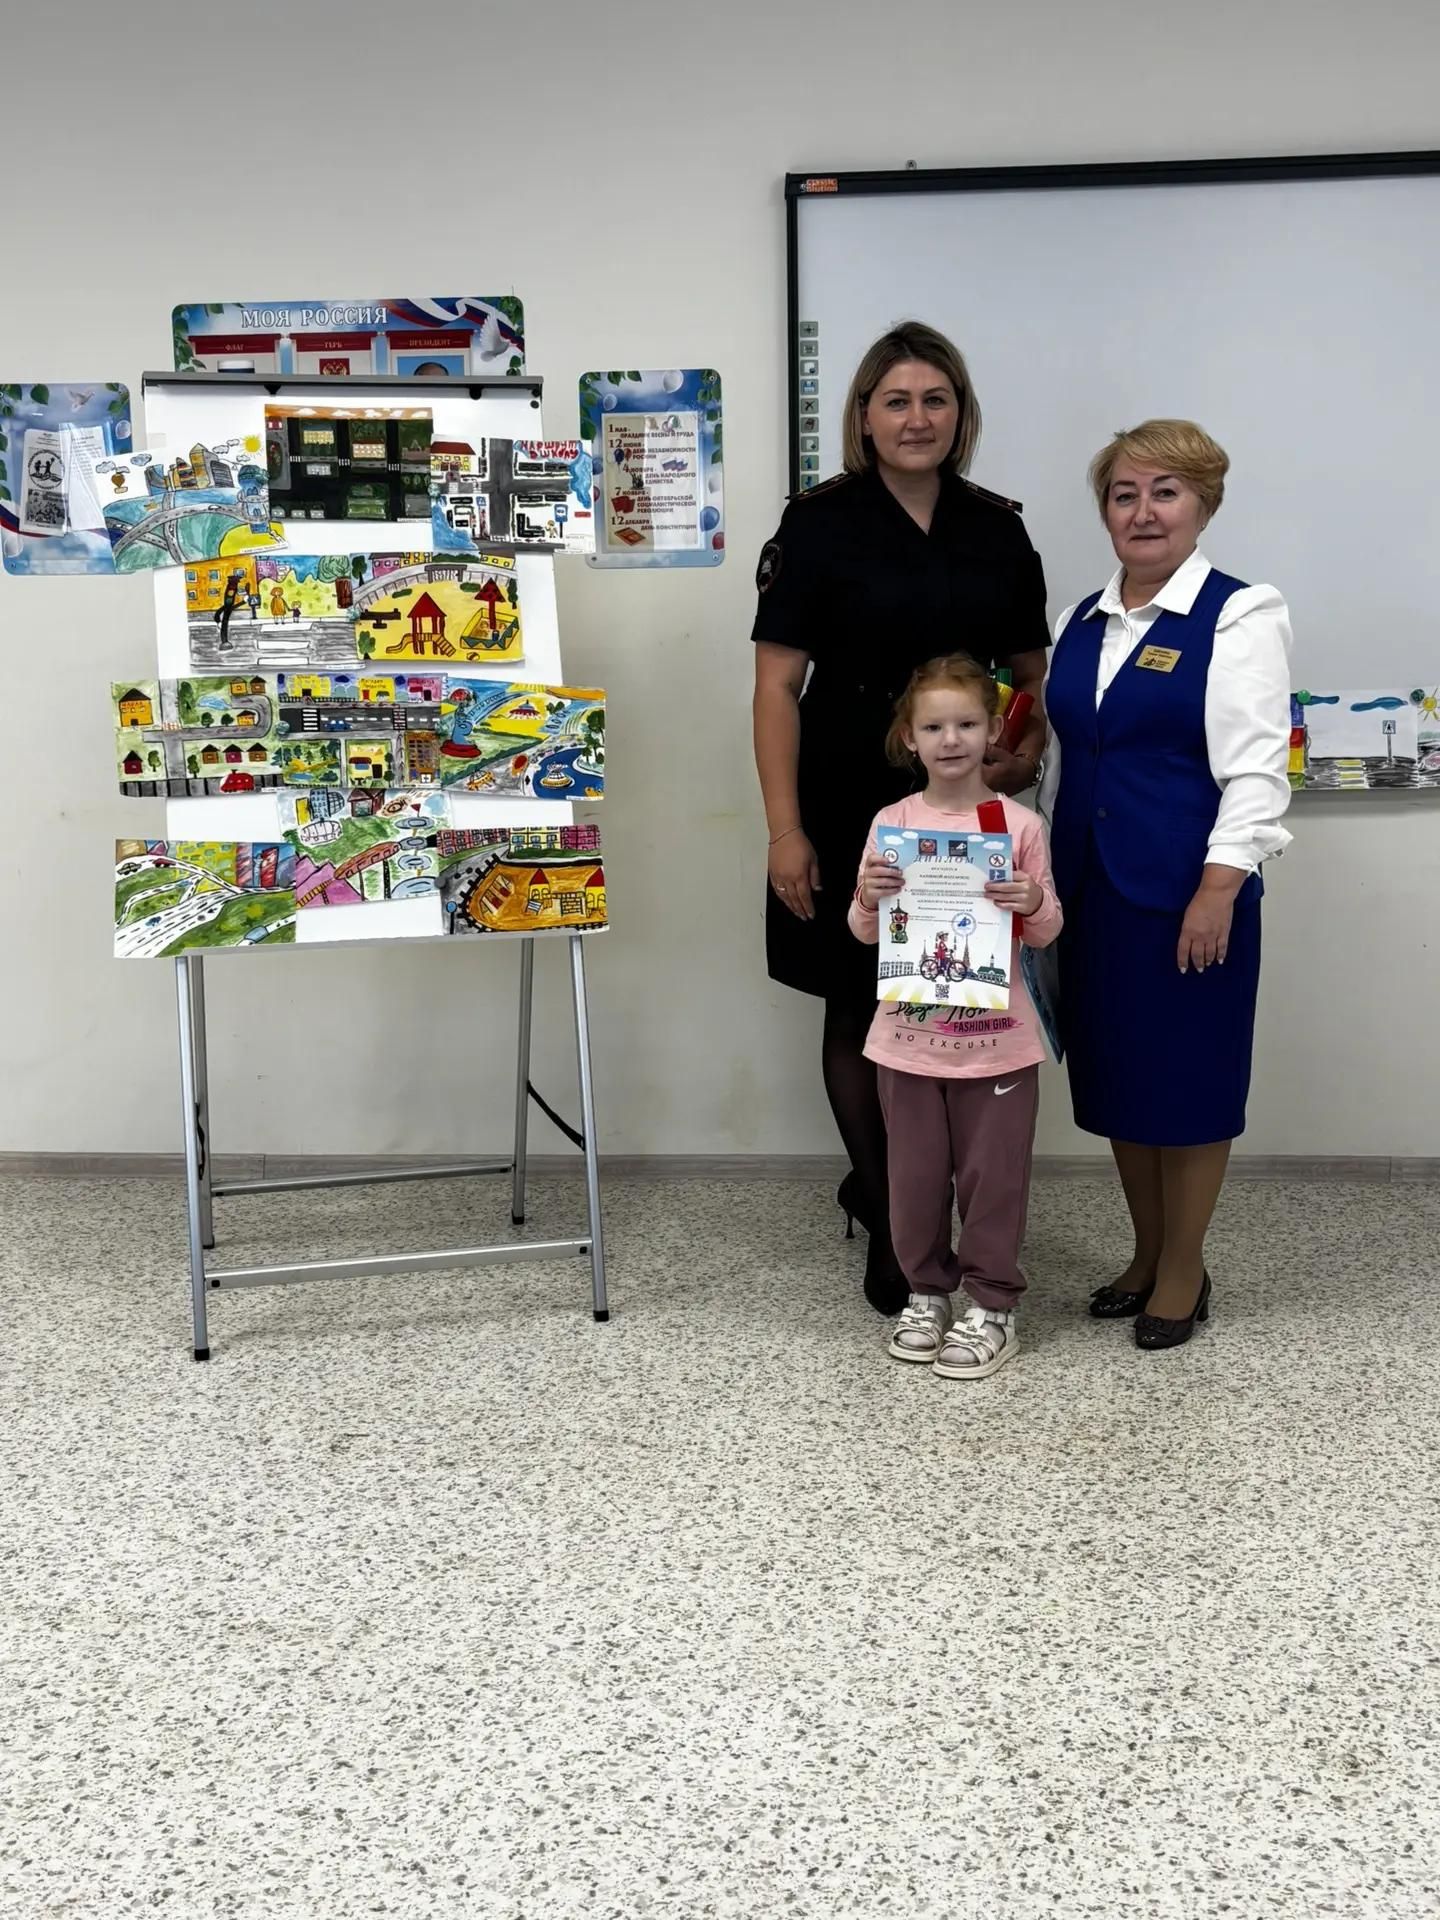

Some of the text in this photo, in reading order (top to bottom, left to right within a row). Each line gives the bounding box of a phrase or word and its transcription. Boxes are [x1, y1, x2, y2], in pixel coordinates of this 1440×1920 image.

[240, 306, 388, 328] МОЯ РОССИЯ
[409, 339, 450, 347] ПРЕЗИДЕНТ
[608, 423, 614, 433] 1
[609, 438, 622, 448] 12
[623, 464, 629, 473] 4
[615, 487, 621, 496] 7
[611, 516, 624, 526] 12
[913, 854, 975, 864] ДИПЛОМ
[953, 1017, 1012, 1033] FASHION GIRL
[894, 1032, 998, 1050] NO EXCUSE
